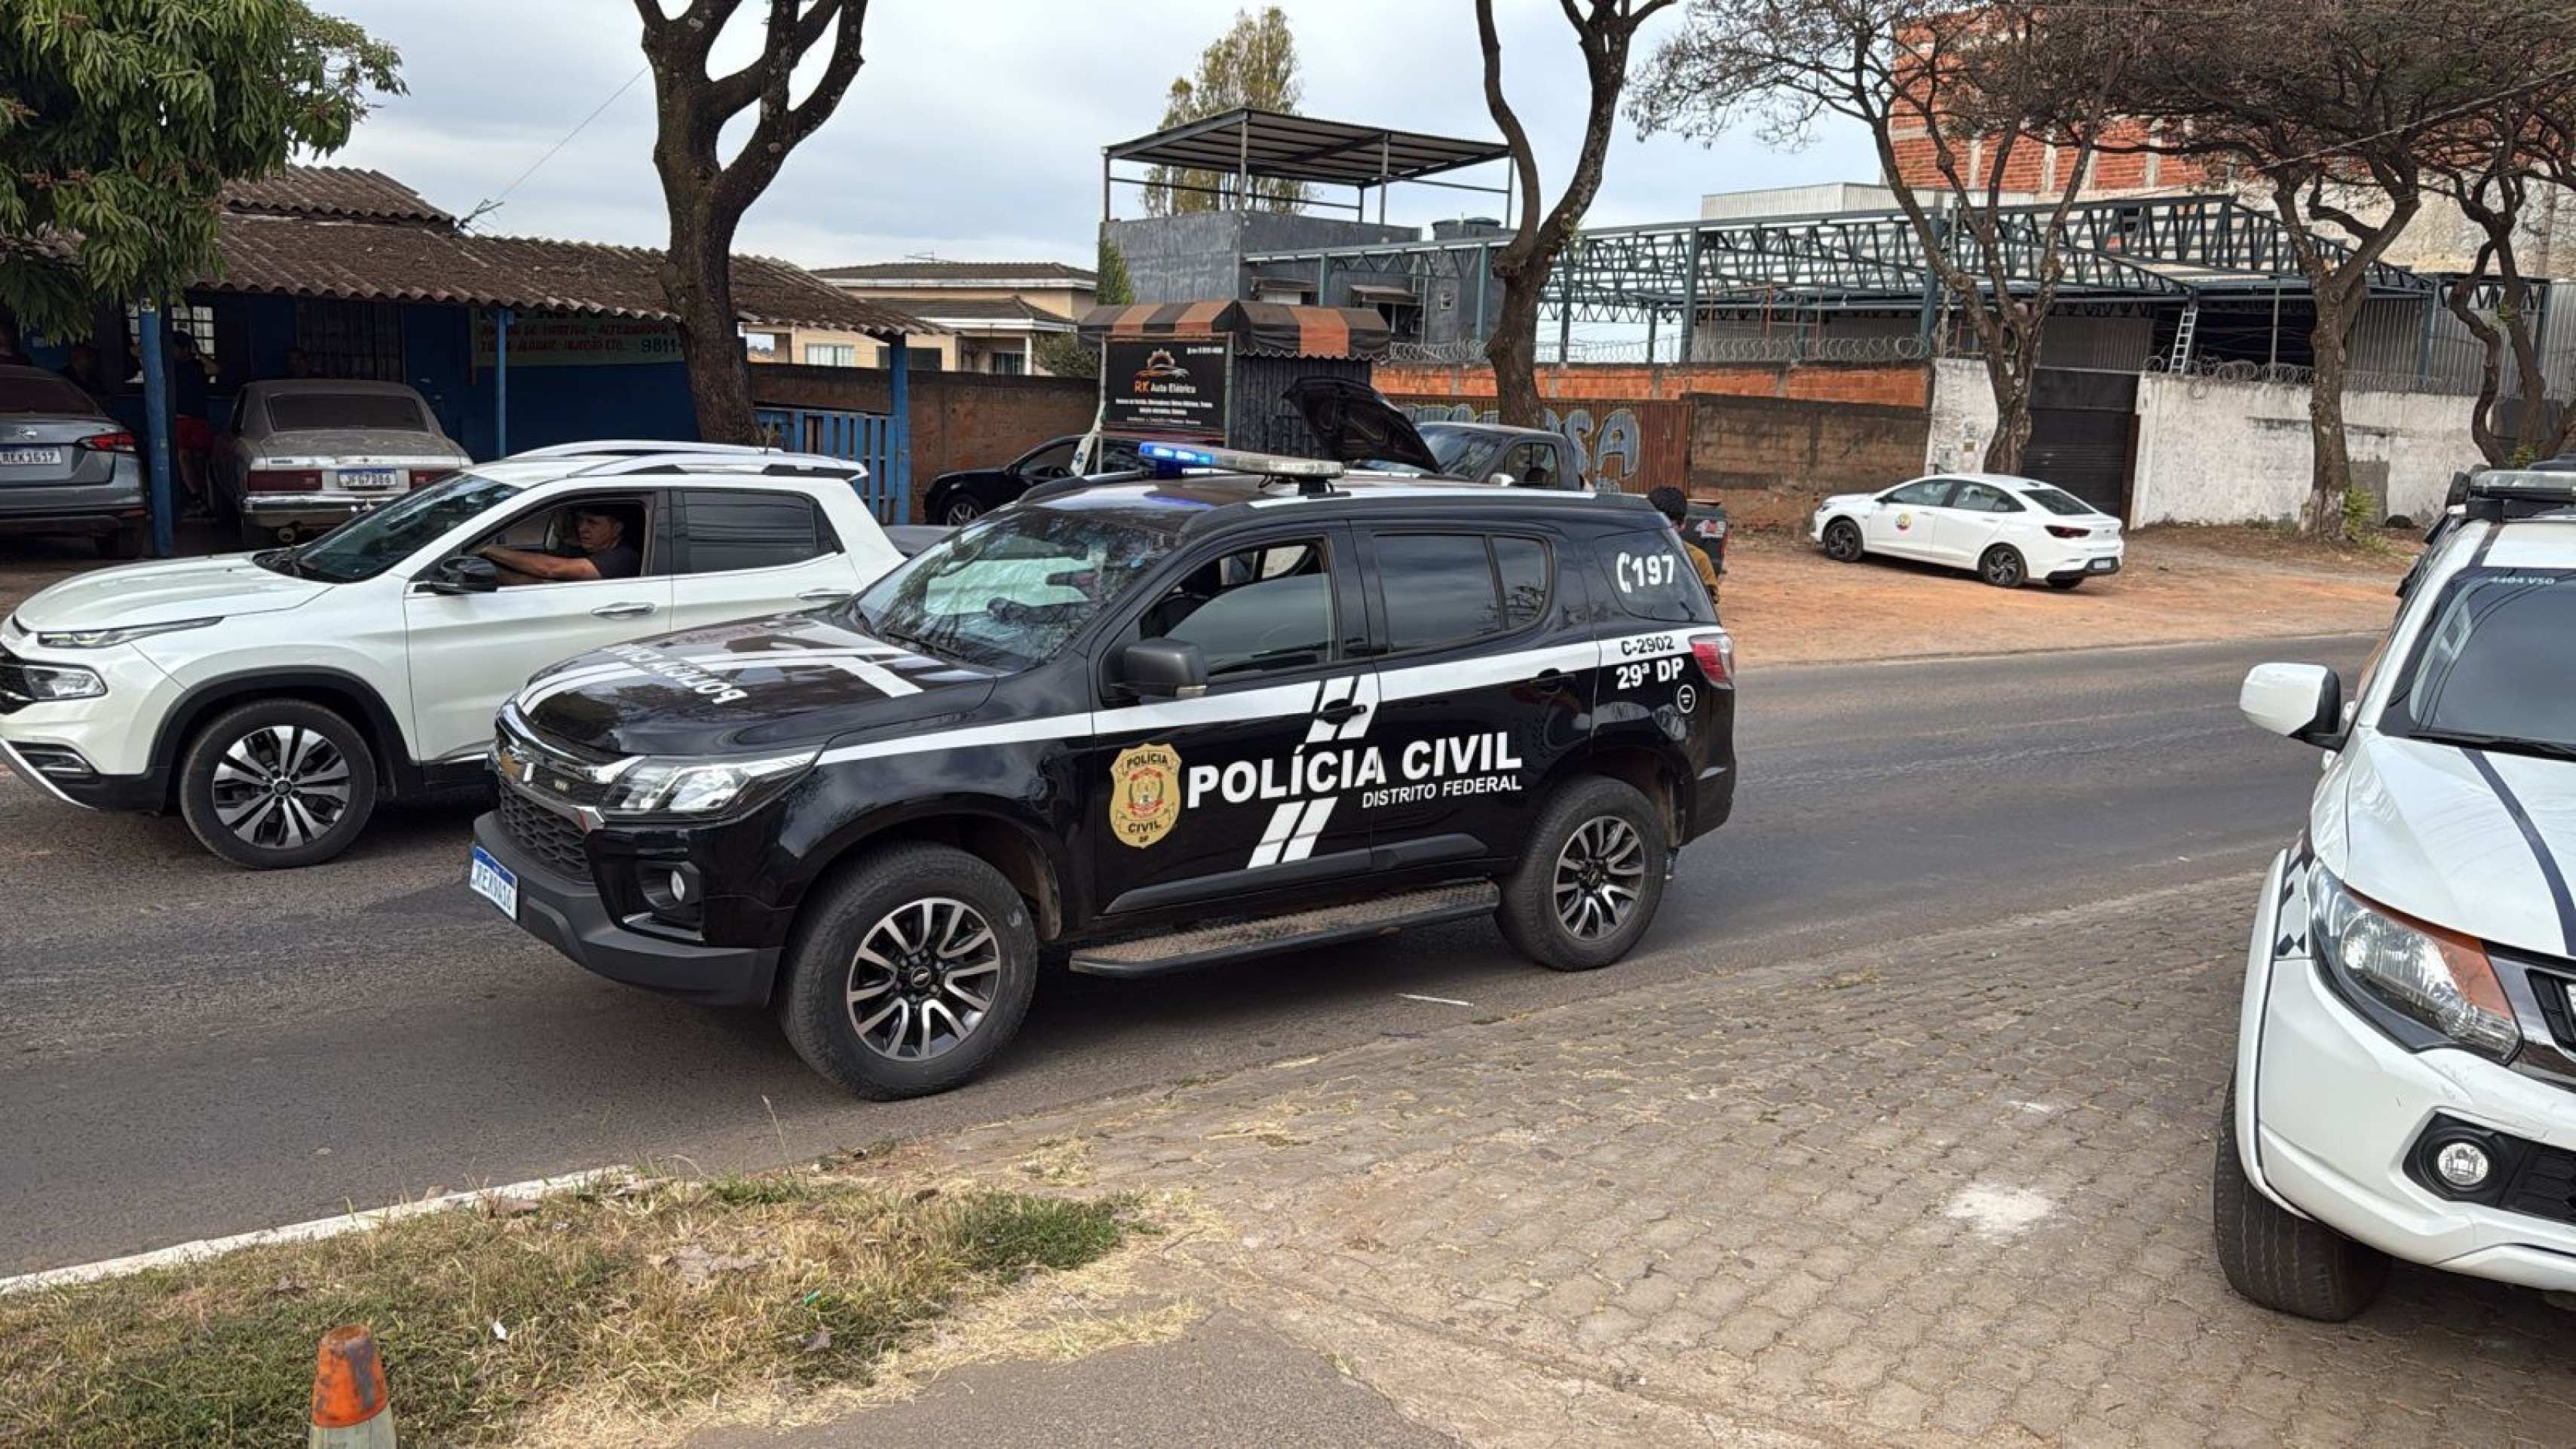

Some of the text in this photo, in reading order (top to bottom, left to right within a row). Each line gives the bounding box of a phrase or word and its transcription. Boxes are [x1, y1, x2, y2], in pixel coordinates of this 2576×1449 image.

[1134, 381, 1150, 394] RK
[1631, 555, 1674, 587] 197
[1622, 636, 1674, 655] C-2902
[1656, 657, 1684, 683] DP
[1187, 731, 1523, 808] POLÍCIA CIVIL
[1362, 775, 1523, 809] DISTRITO FEDERAL
[1128, 820, 1162, 834] CIVIL
